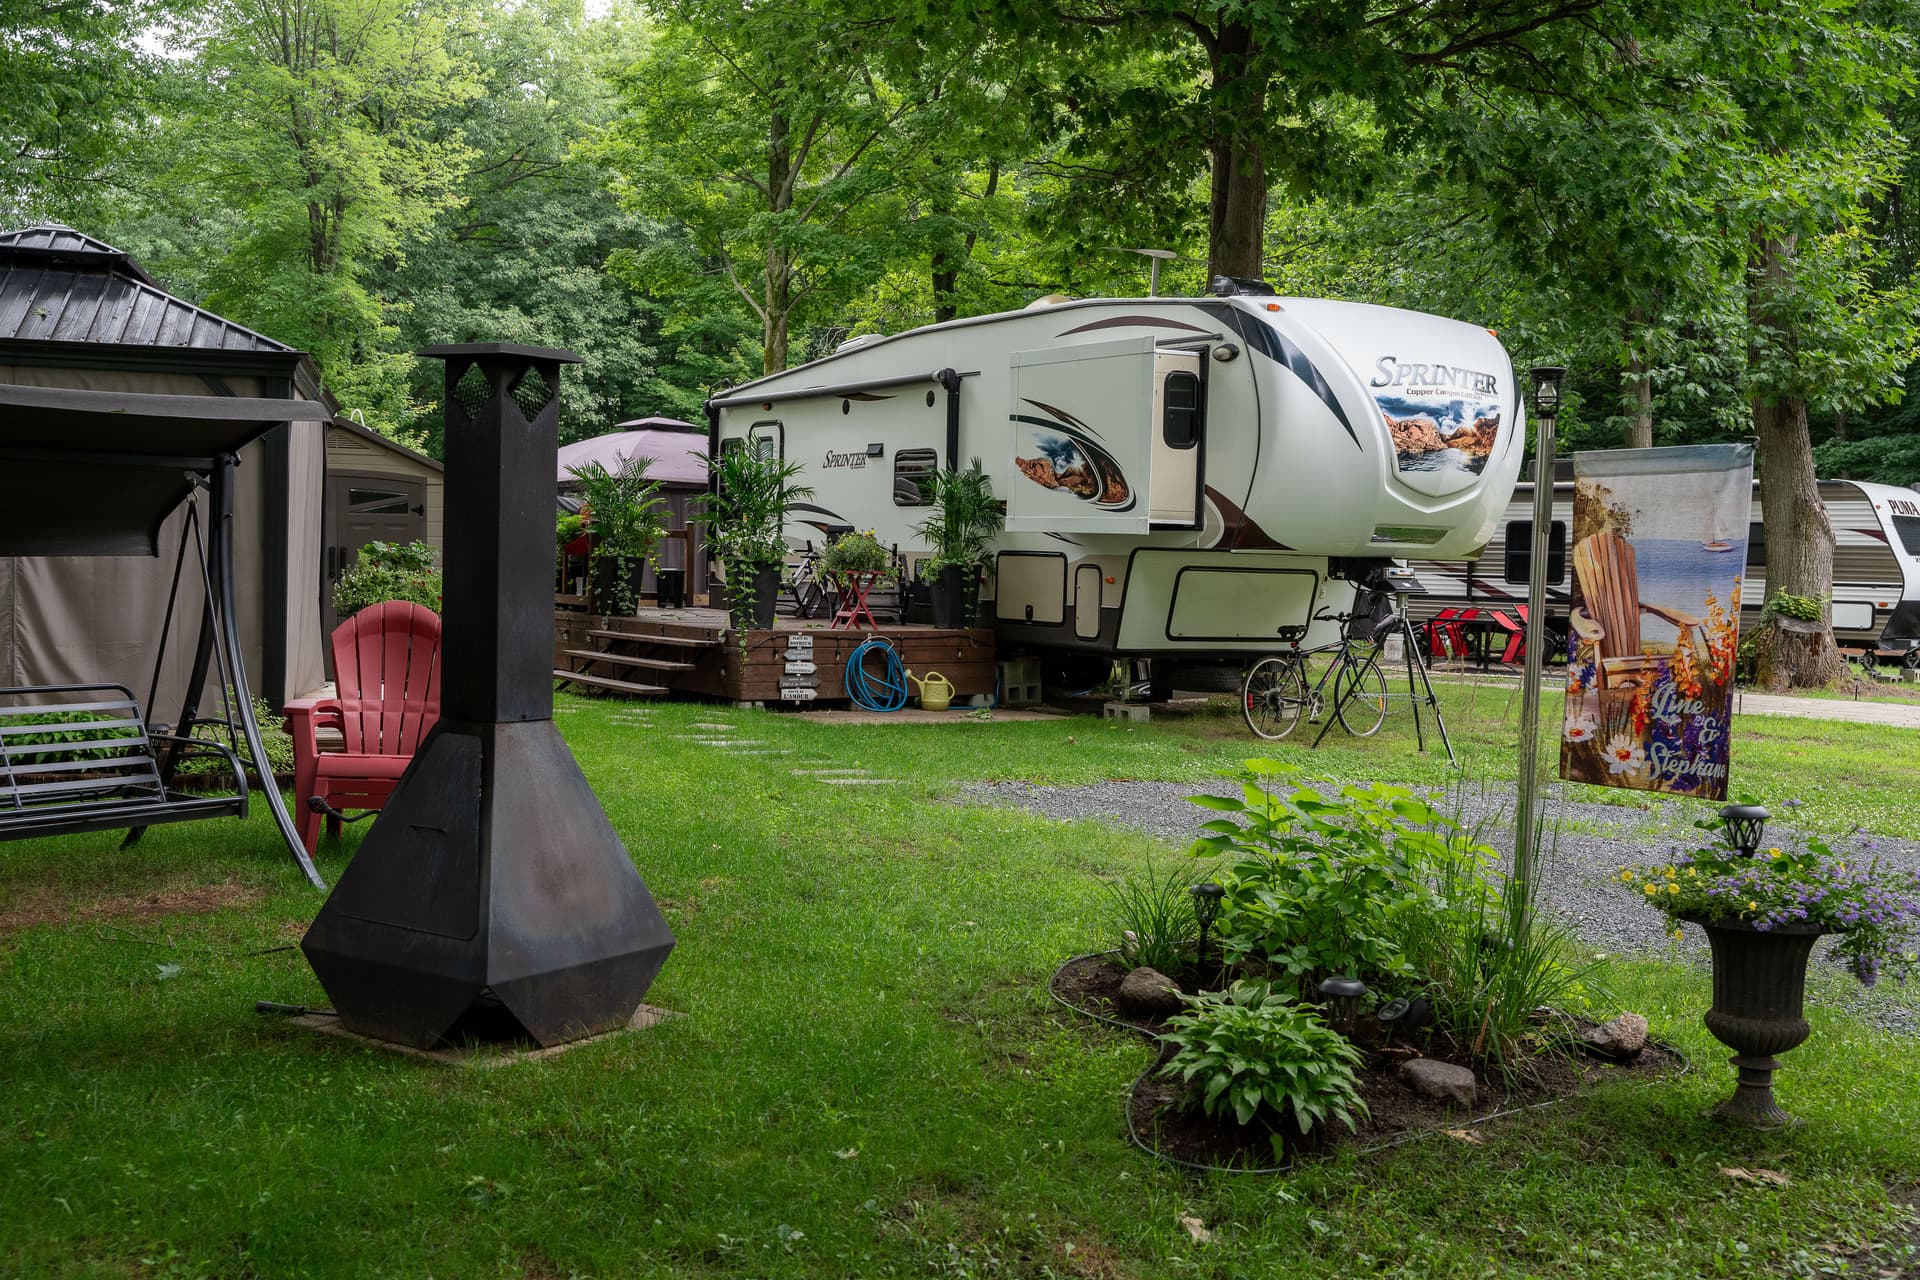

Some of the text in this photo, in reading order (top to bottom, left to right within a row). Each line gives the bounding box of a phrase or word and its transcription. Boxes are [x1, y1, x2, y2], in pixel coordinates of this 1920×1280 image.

[1371, 356, 1498, 395] SPRINTER
[1406, 388, 1434, 396] Copper
[823, 450, 867, 468] SPRINTER
[1887, 499, 1920, 516] PUMA
[1651, 682, 1705, 725] Line
[1699, 717, 1718, 743] &
